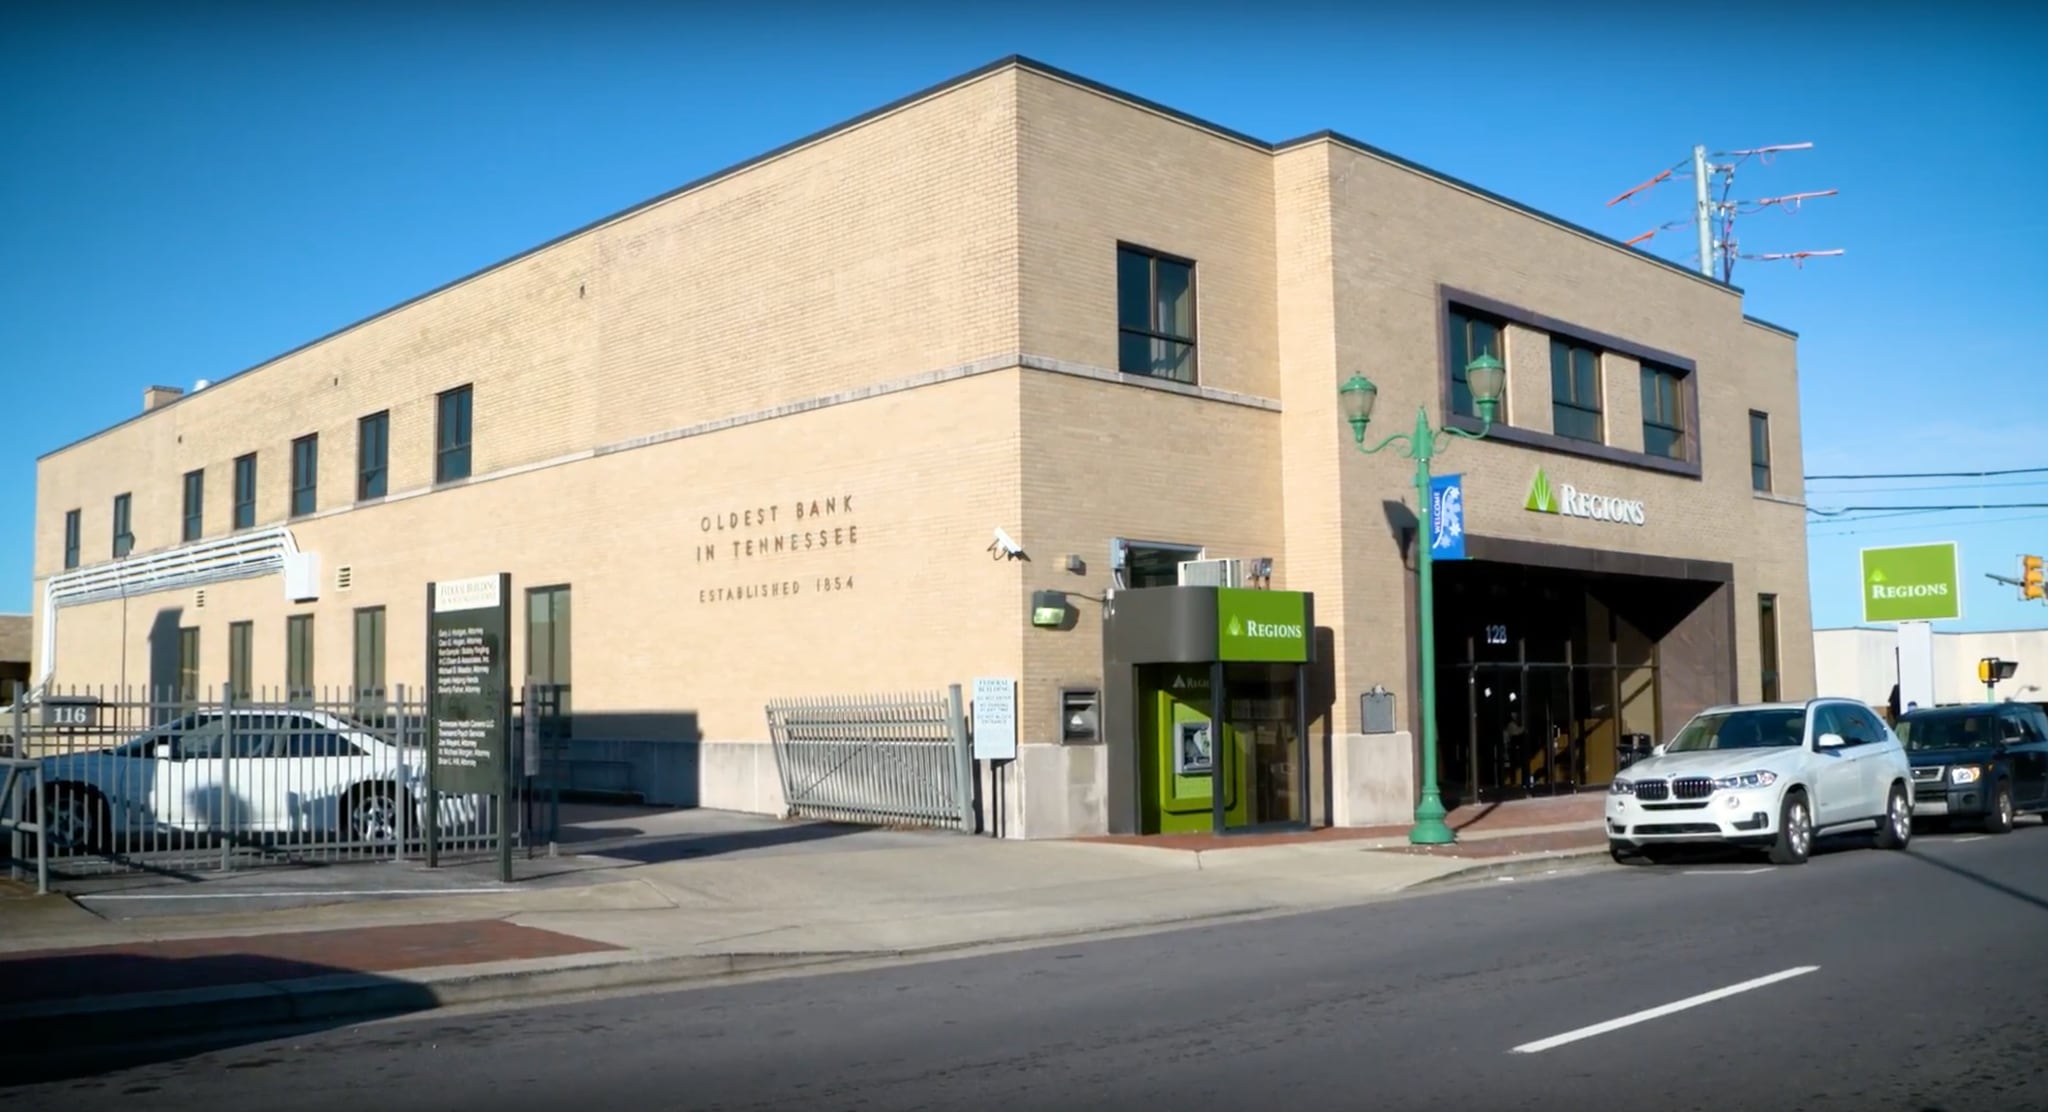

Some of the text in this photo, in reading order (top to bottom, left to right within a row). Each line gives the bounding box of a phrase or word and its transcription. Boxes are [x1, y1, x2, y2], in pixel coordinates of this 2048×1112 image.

[700, 495, 852, 533] OLDEST BANK
[1433, 491, 1441, 534] WELCOME
[1560, 484, 1645, 526] REGIONS
[697, 525, 858, 563] IN TENNESSEE
[699, 576, 853, 603] ESTABLISHED 1854
[1872, 583, 1948, 600] REGIONS
[1247, 619, 1303, 639] REGIONS
[1485, 624, 1508, 644] 128
[53, 707, 87, 724] 116
